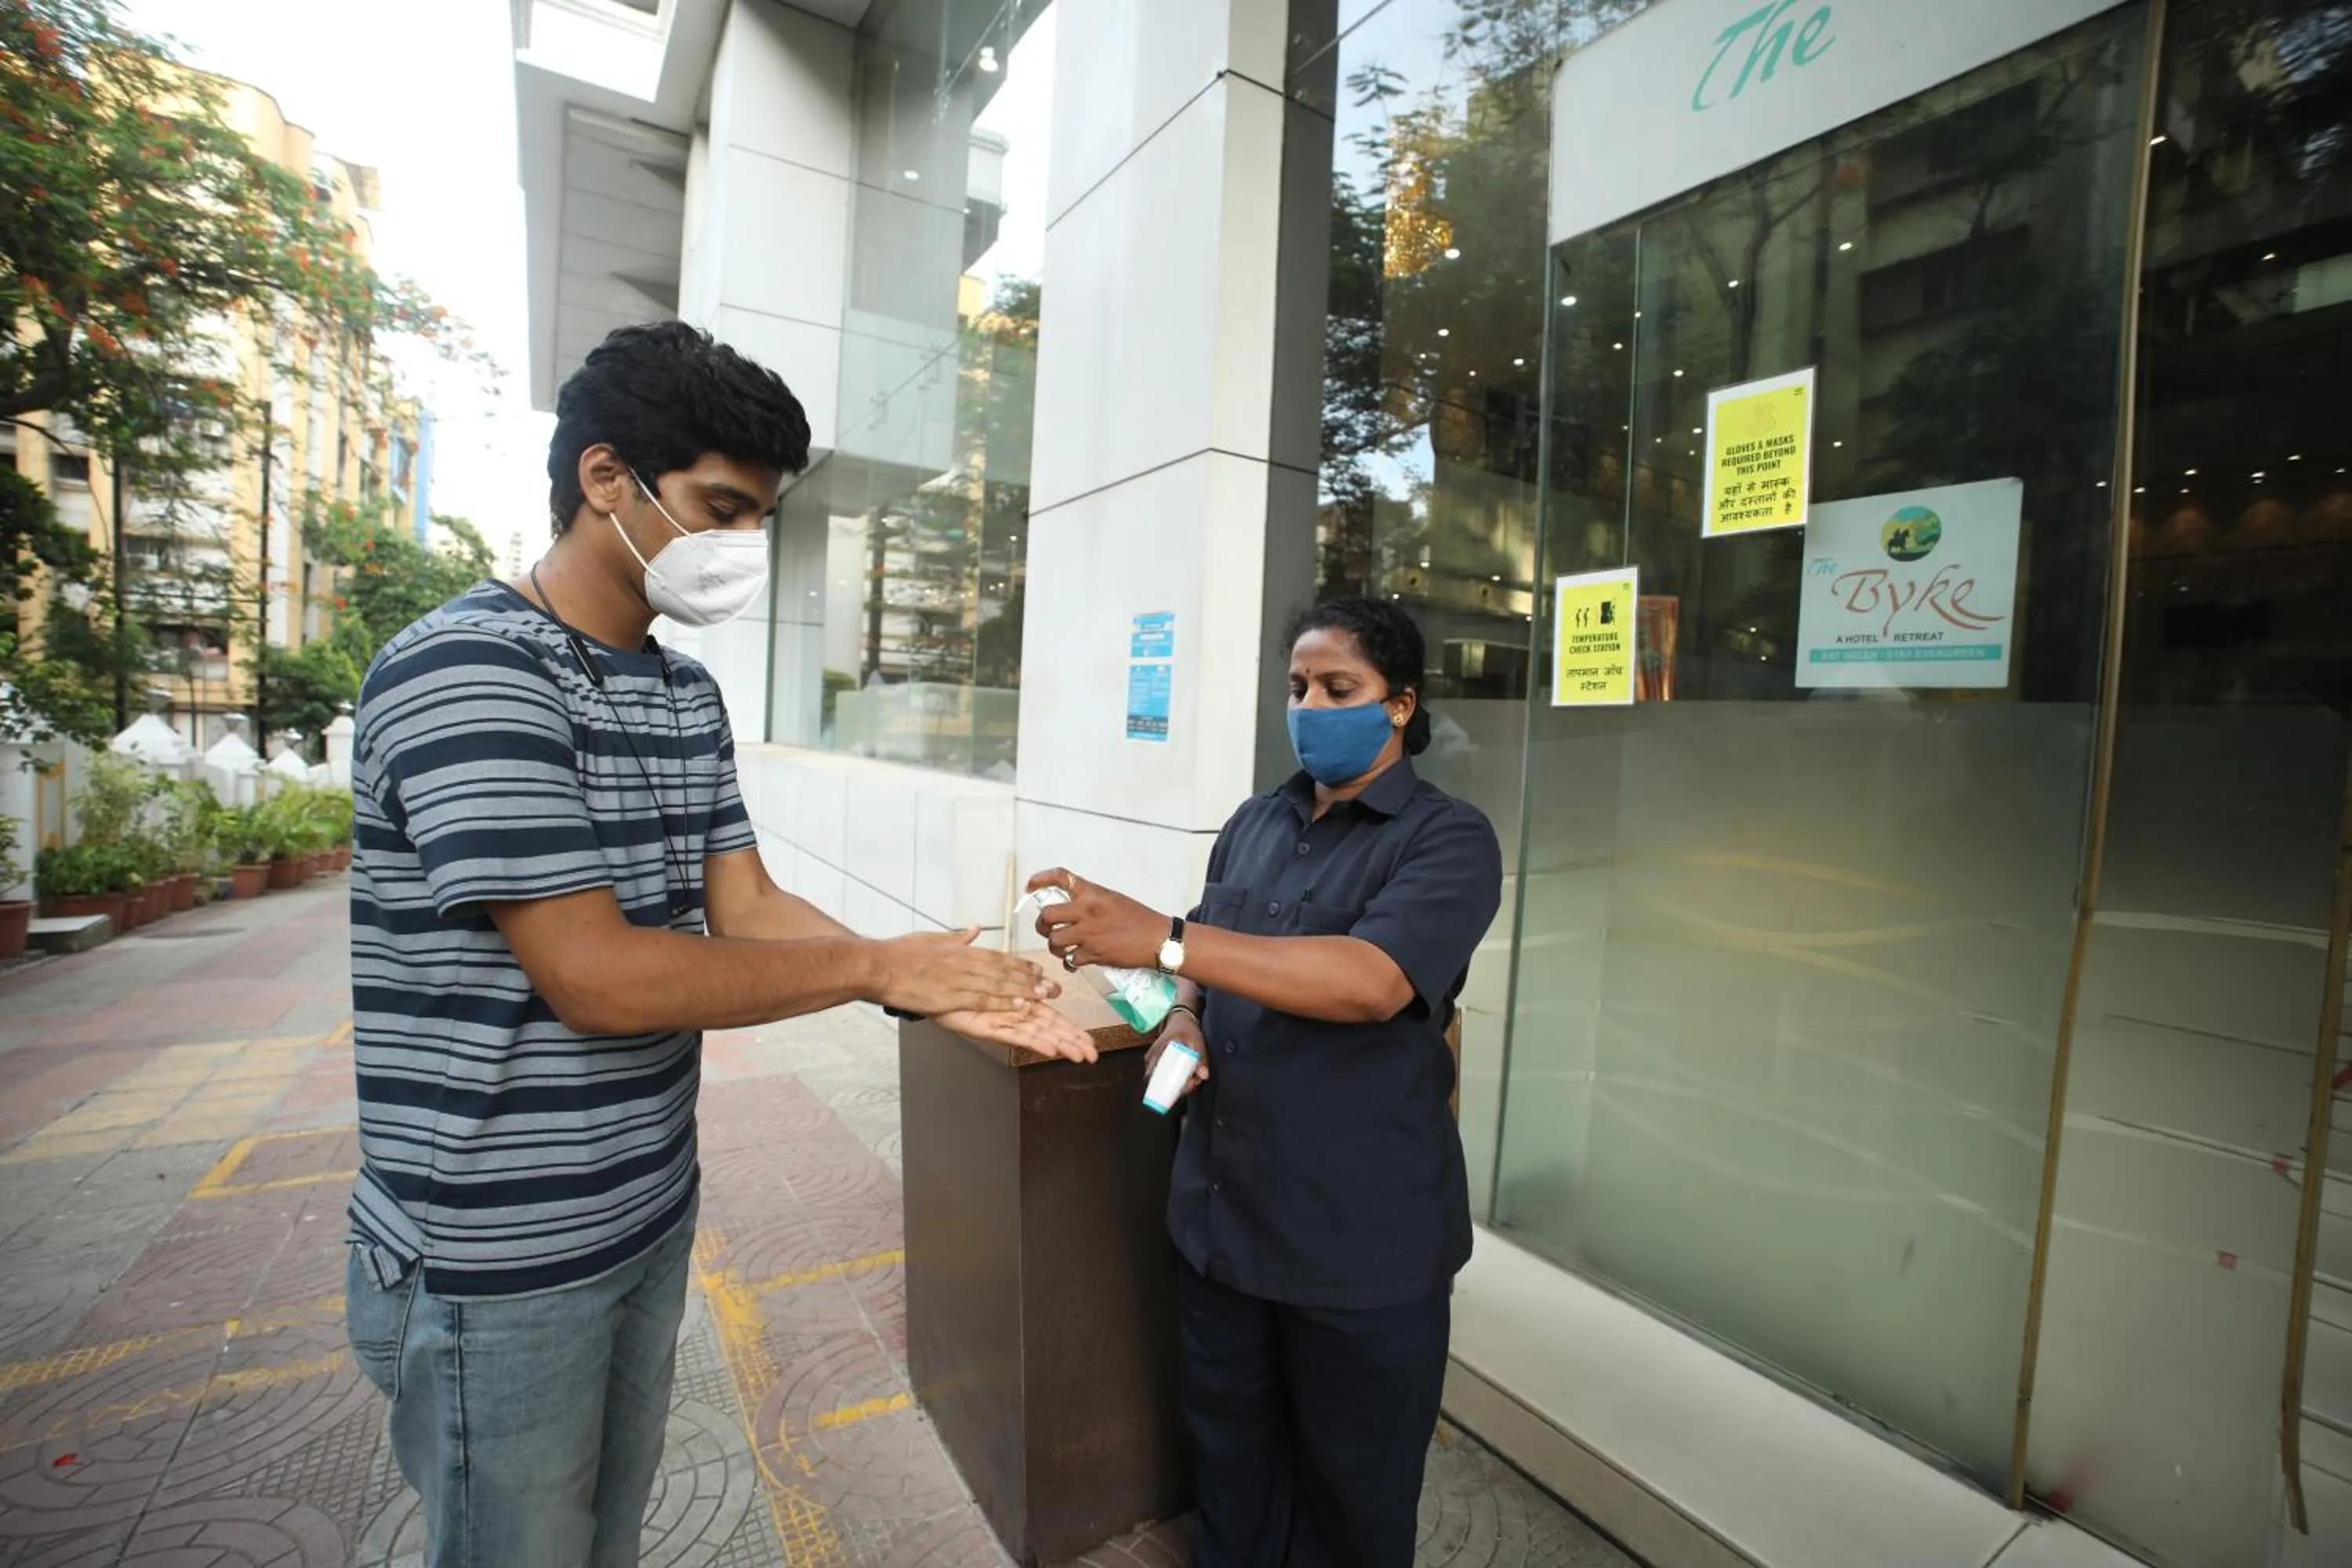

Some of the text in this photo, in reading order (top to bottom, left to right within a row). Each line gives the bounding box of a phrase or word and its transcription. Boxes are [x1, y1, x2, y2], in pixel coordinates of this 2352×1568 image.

[1692, 0, 1837, 111] The
[1726, 441, 1755, 456] GLOVES
[1766, 434, 1795, 447] MASKS
[1721, 445, 1795, 467] REQUIRED BEYOND
[1737, 459, 1781, 475] THIS POINT
[1747, 481, 1756, 492] से
[1761, 476, 1791, 489] मास्क
[1718, 496, 1736, 510] और
[1782, 488, 1796, 500] की
[1806, 557, 1838, 576] The
[1831, 564, 2007, 639] Byke
[1572, 633, 1618, 643] TEMPERATURE
[1835, 631, 1944, 644] A HOTEL RETREAT
[1570, 643, 1621, 654] CHECK STATION
